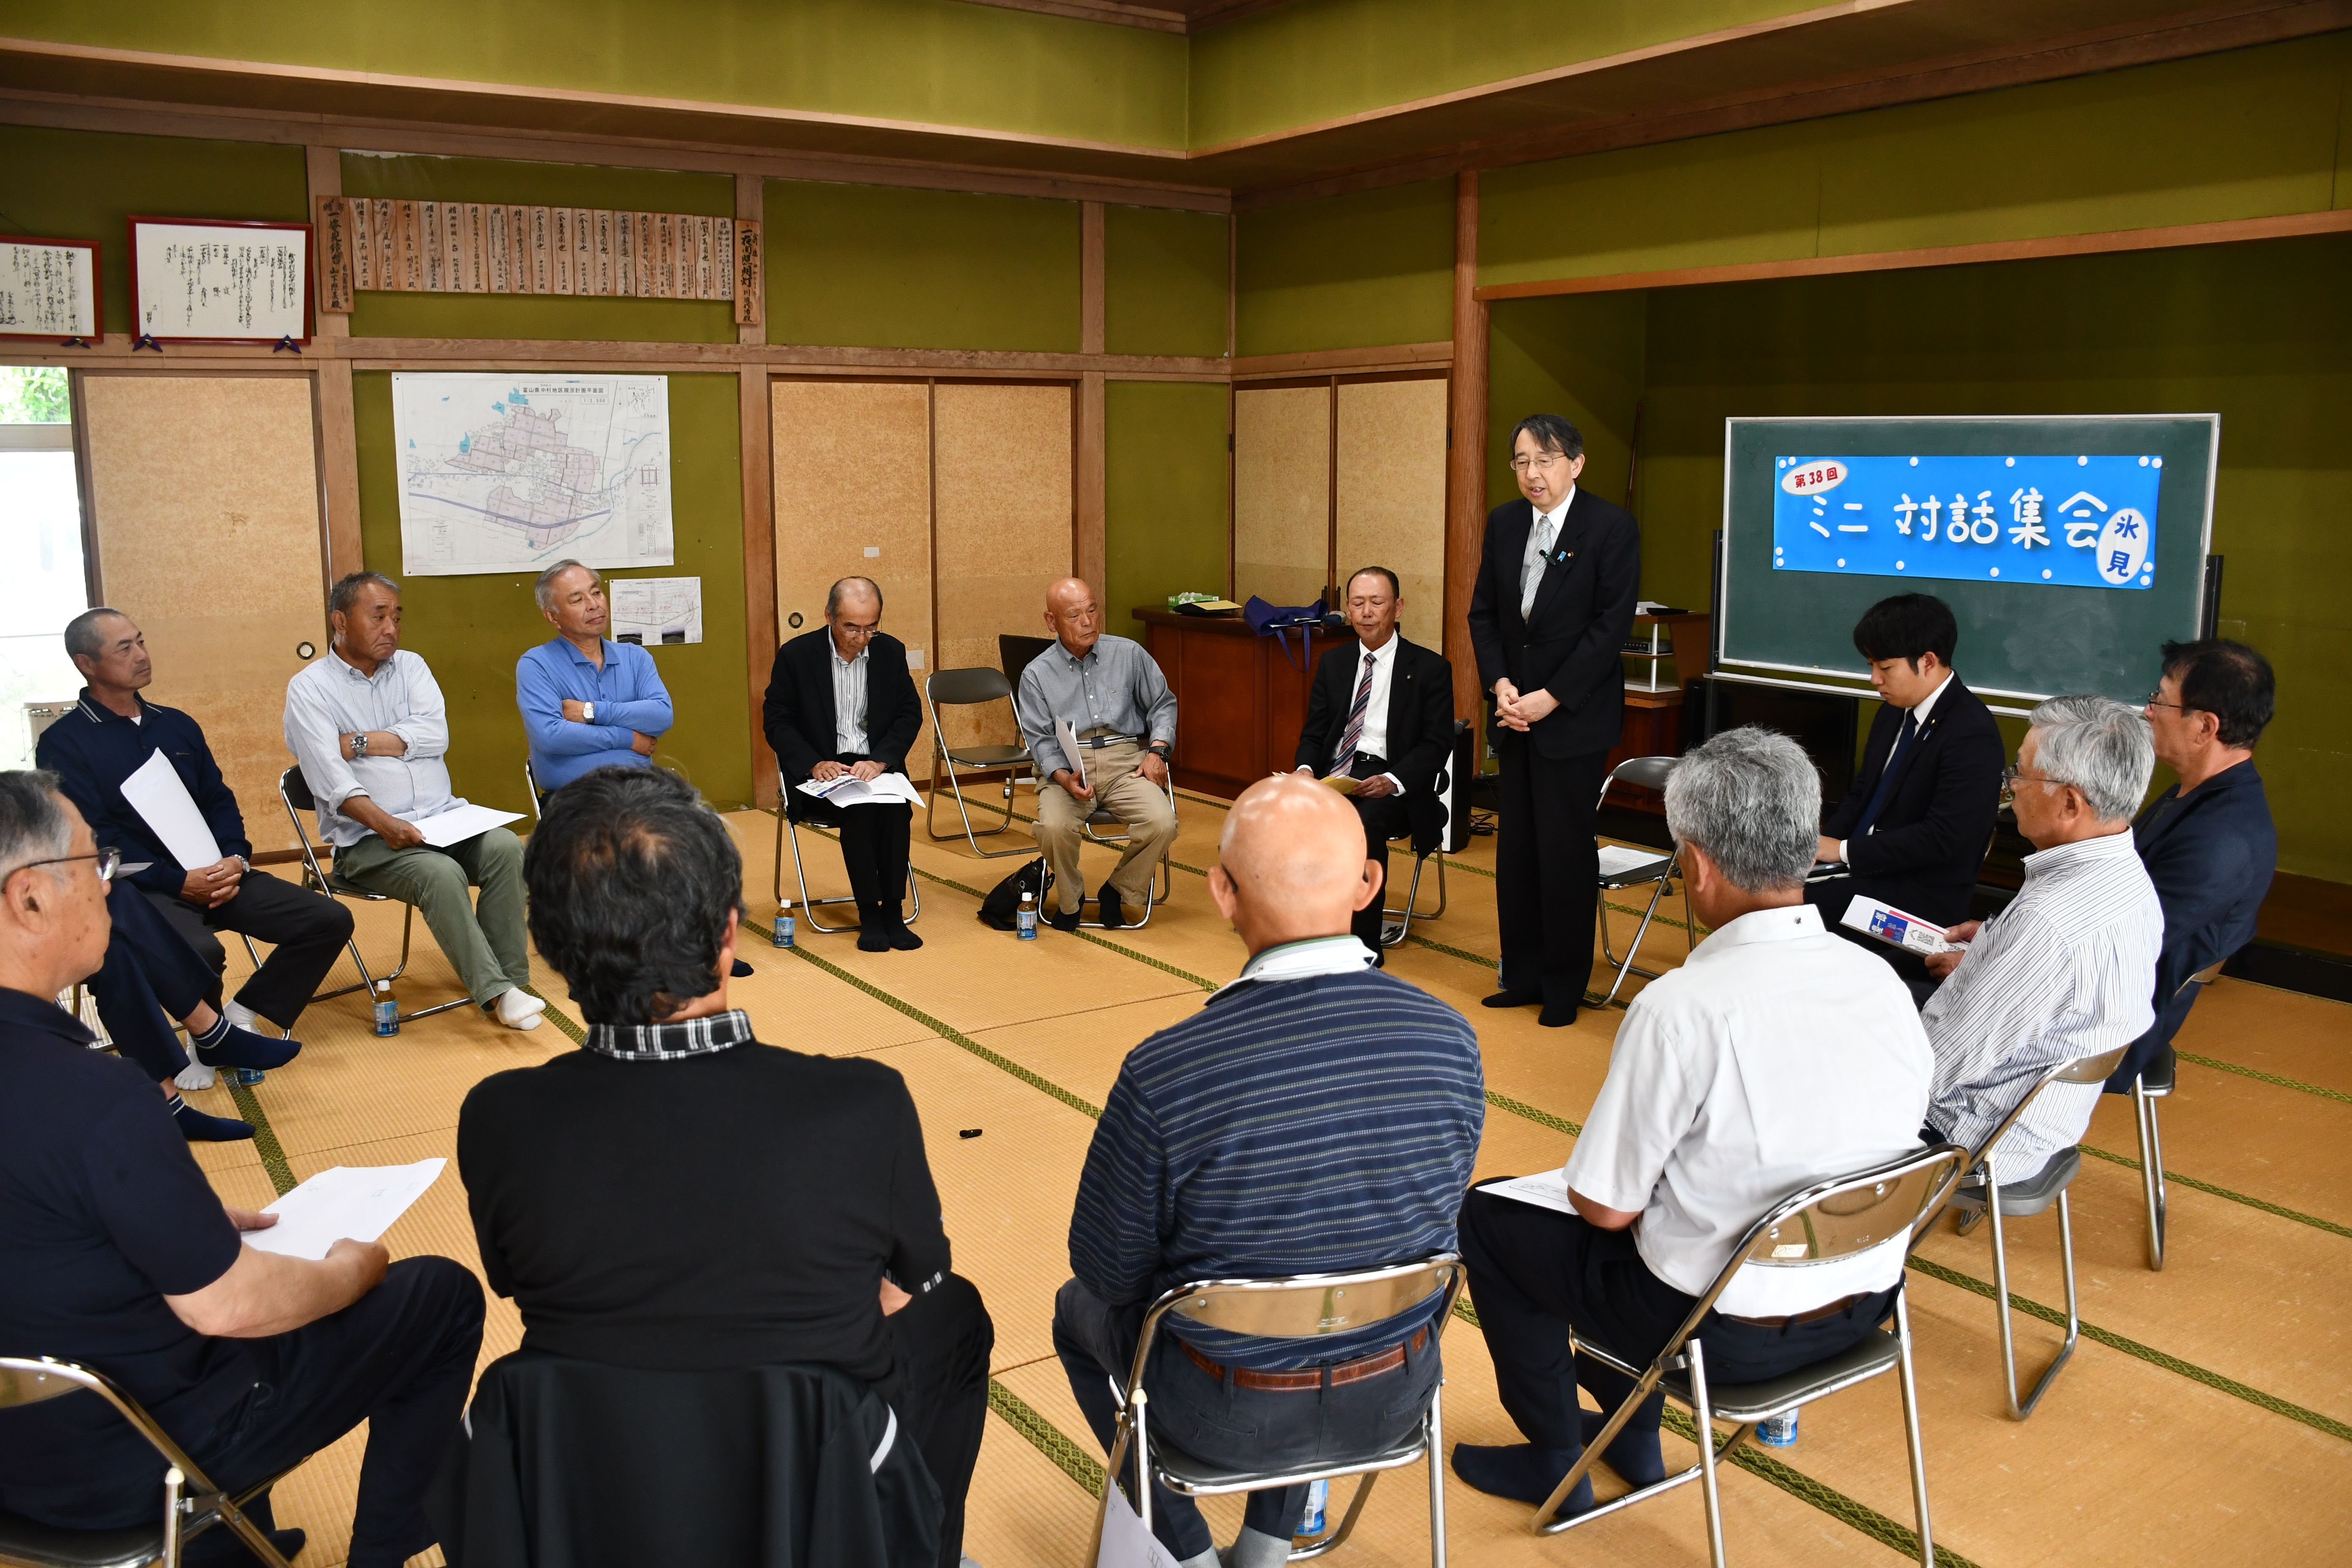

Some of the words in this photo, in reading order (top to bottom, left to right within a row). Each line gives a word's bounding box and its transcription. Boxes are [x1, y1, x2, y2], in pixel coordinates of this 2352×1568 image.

[1794, 467, 1838, 488] 第38回
[1809, 495, 1868, 538] ミニ
[1894, 487, 2108, 550] 対話集会
[2106, 514, 2140, 577] 氷見
[1871, 912, 1887, 935] 慶一郎
